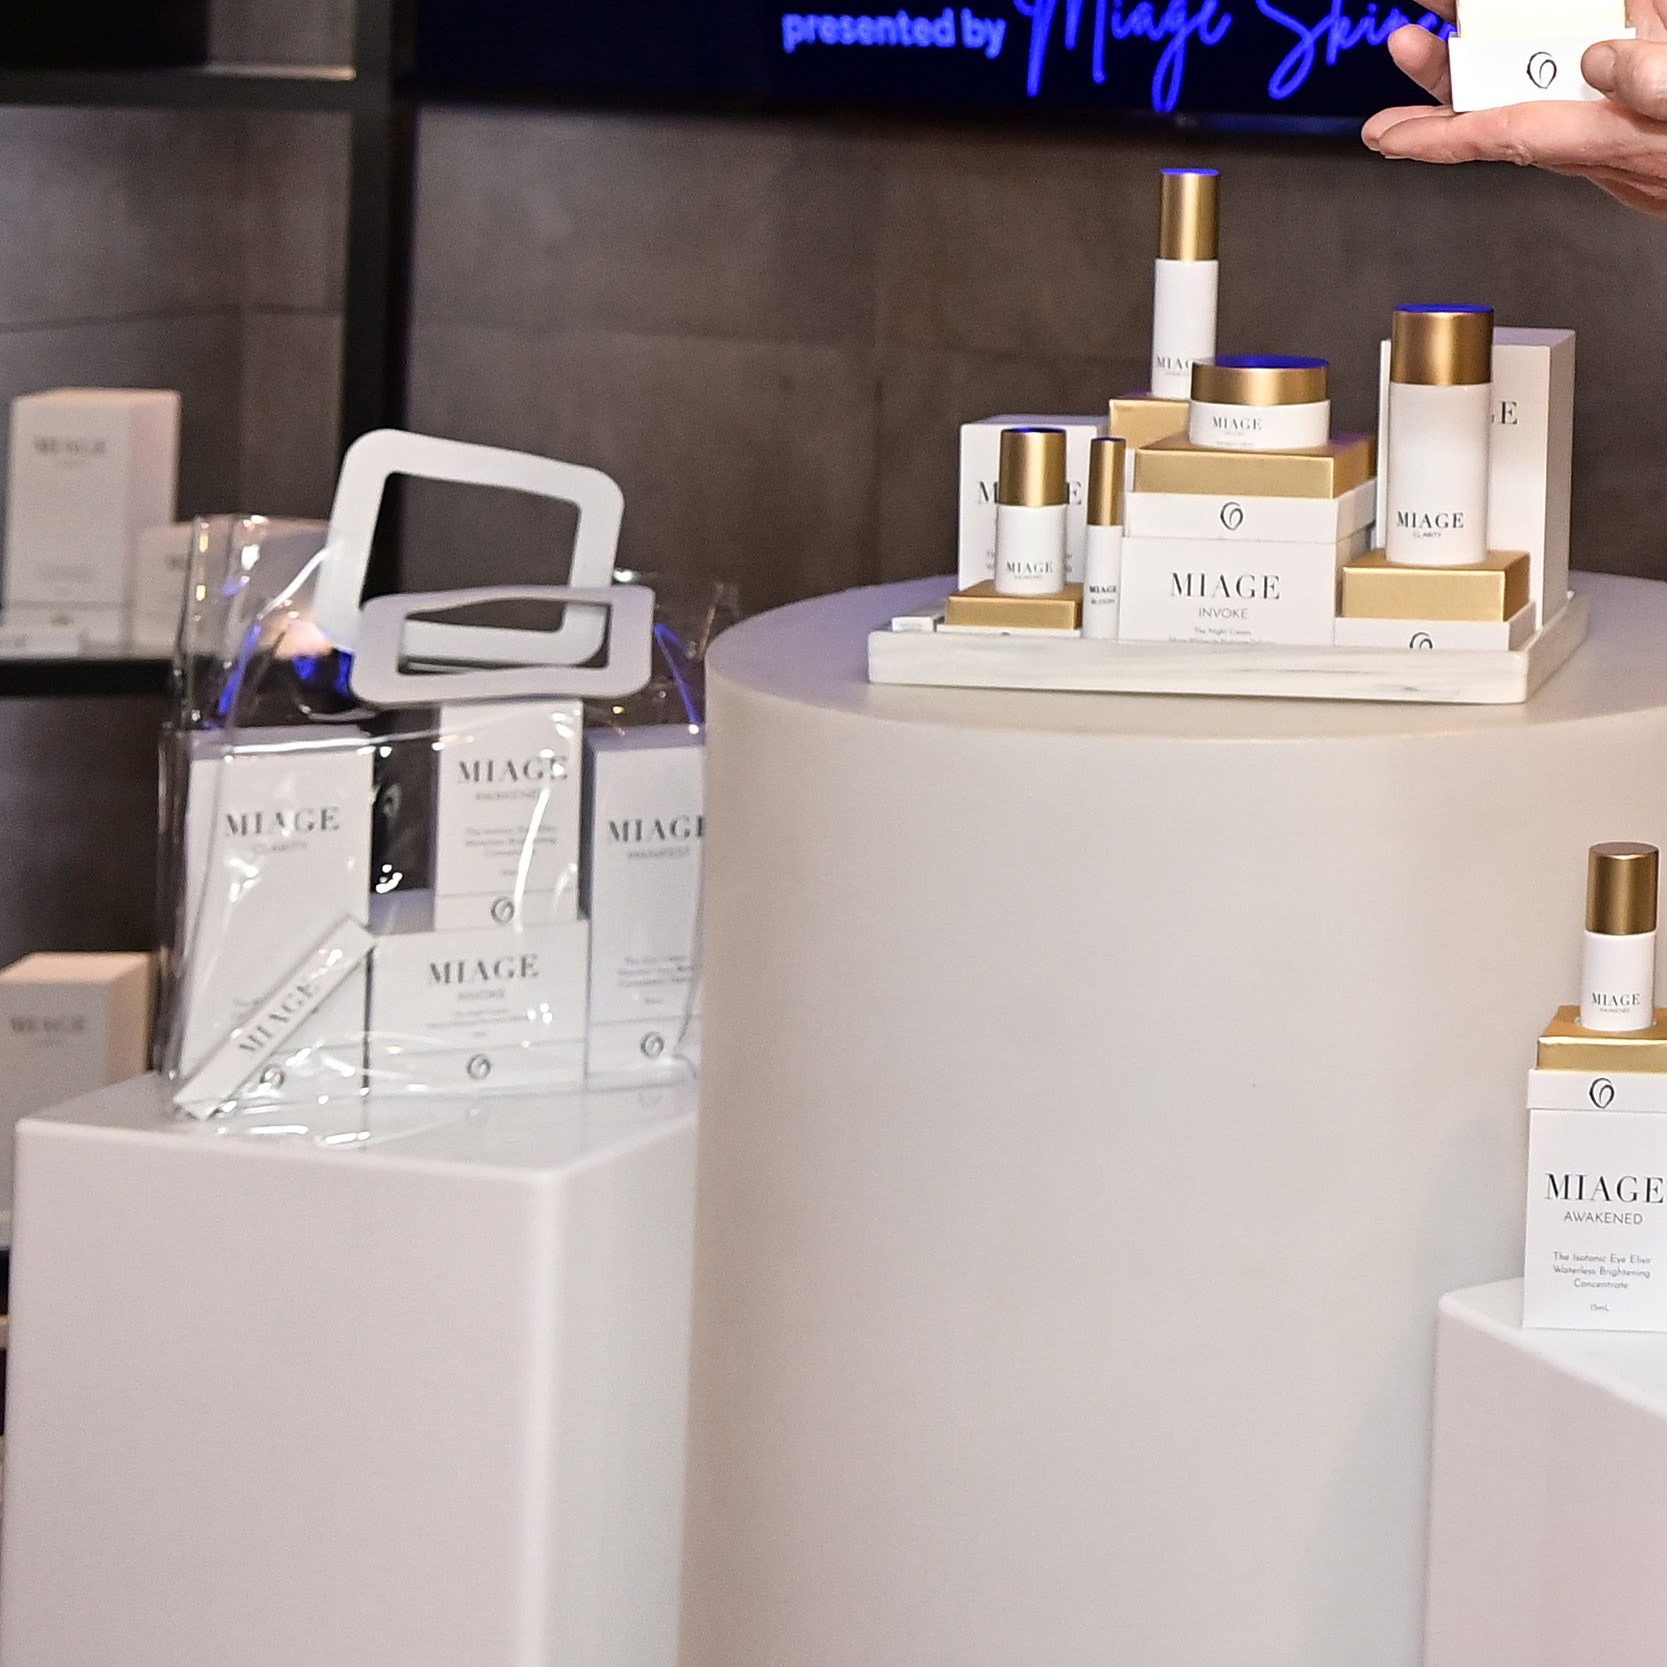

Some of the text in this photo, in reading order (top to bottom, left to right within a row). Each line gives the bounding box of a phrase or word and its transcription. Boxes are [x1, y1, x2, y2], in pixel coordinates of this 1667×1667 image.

[782, 8, 954, 53] presented
[960, 8, 1006, 58] by
[1156, 356, 1192, 370] MIA
[1212, 416, 1263, 431] MIAGE
[1396, 510, 1465, 530] MIAGE
[1006, 561, 1054, 574] MIAGE
[1168, 572, 1281, 601] MIAGE
[1198, 607, 1248, 620] INVOKE
[225, 805, 341, 837] MIAGE
[427, 952, 540, 987] MIAGE
[1591, 992, 1641, 1007] MIAGE
[1544, 1172, 1665, 1204] MIAGE
[1563, 1210, 1644, 1225] AWAKENED
[1553, 1251, 1570, 1261] The
[1610, 1253, 1627, 1264] Eye
[1553, 1265, 1651, 1279] Waterless Brightening
[1573, 1277, 1629, 1289] Concentrate
